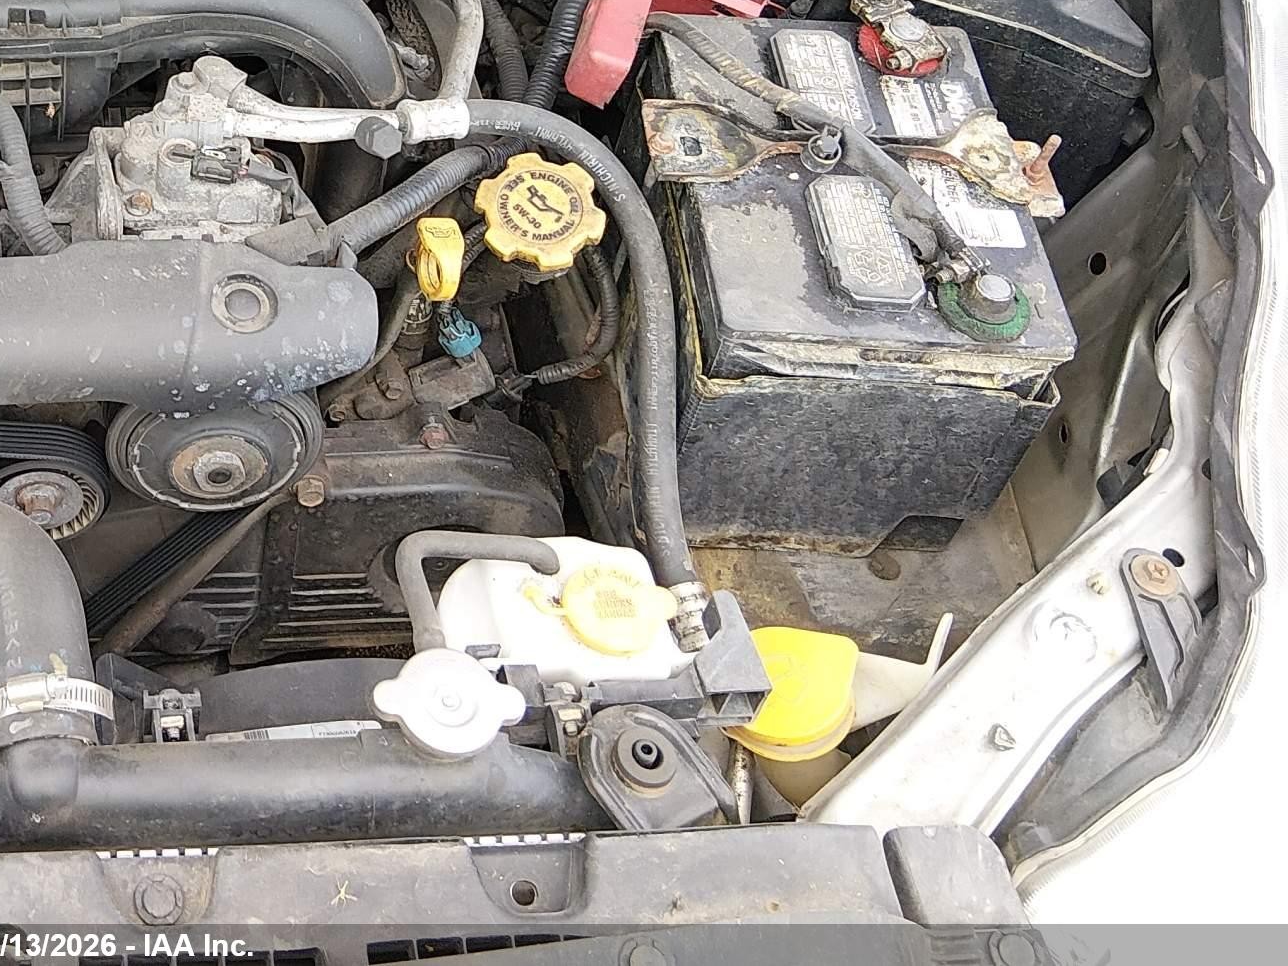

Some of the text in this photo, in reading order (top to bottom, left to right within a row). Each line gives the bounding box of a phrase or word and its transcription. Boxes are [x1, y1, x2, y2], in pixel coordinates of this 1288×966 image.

[500, 174, 575, 242] SEE OWNER'S MANUAL
[530, 172, 580, 214] ENGINE OIL
[513, 204, 542, 229] 5W-30
